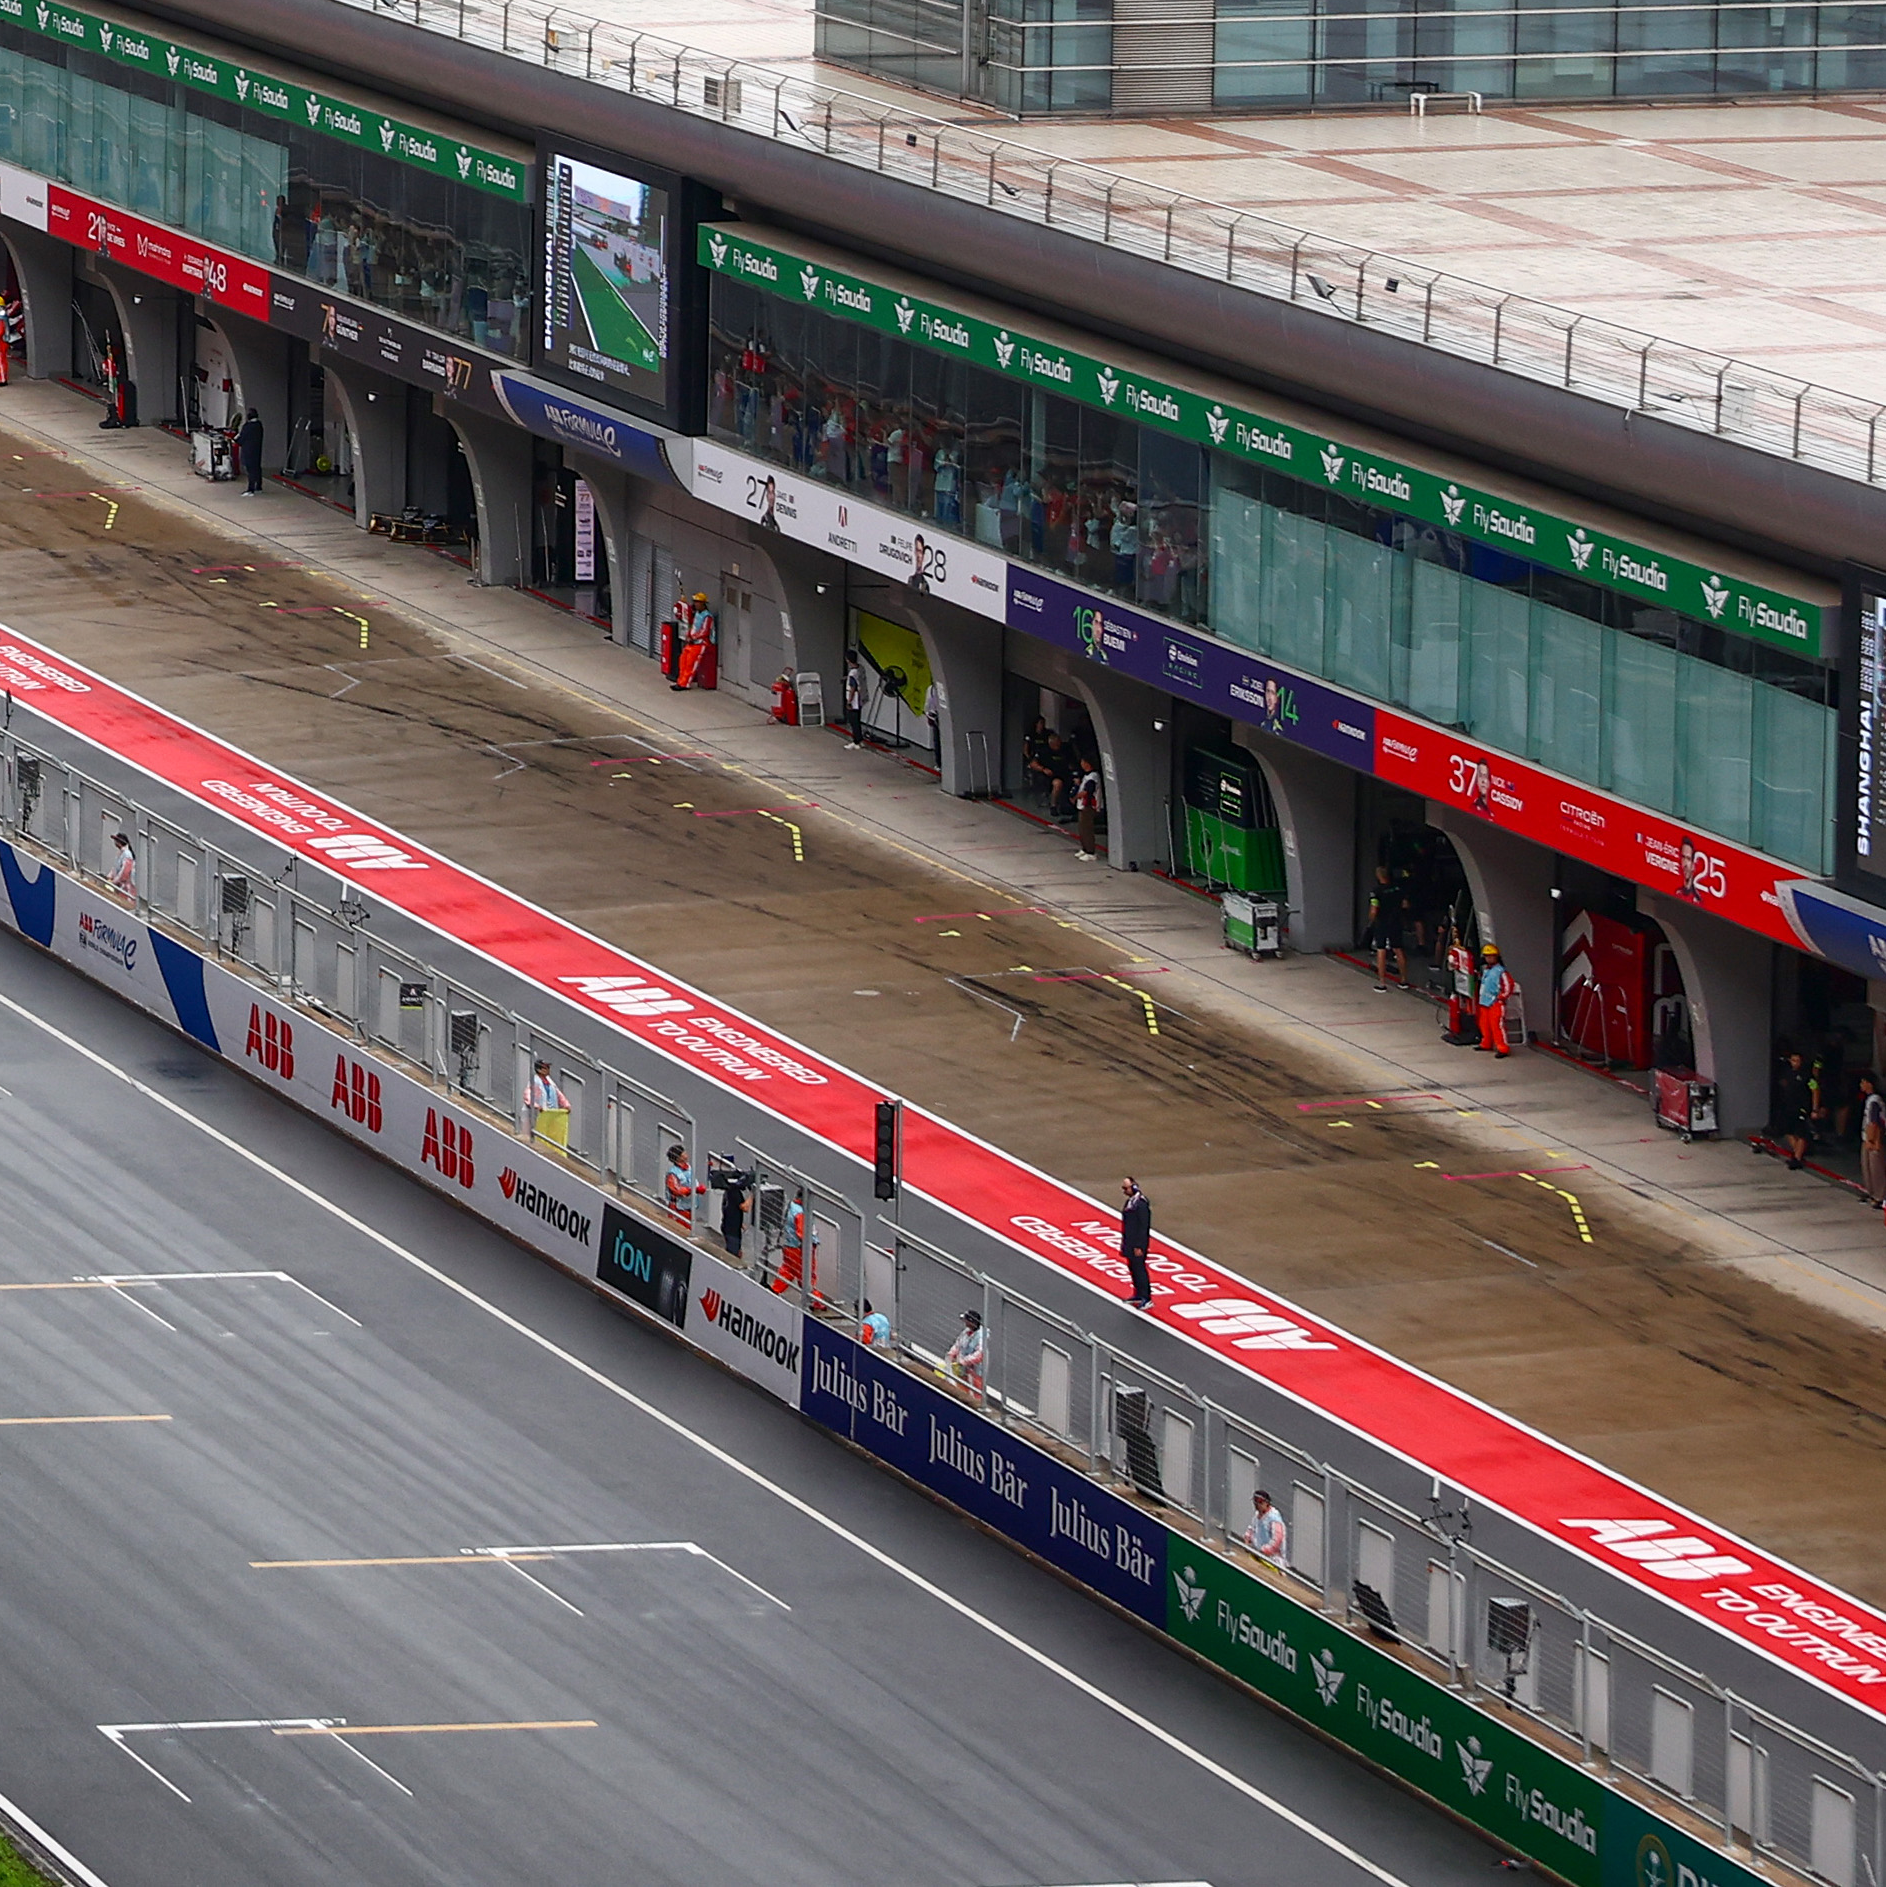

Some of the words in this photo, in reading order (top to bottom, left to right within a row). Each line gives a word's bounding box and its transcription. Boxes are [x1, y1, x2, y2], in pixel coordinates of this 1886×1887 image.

[209, 261, 227, 292] 48
[544, 232, 553, 350] SHANGHAI
[746, 475, 768, 509] 27
[828, 532, 857, 553] ANDRETTI
[879, 543, 913, 565] DRUGOVICH
[923, 545, 946, 583] 28
[1073, 606, 1094, 644] 16
[1229, 684, 1264, 709] ERIKSSON
[1276, 686, 1300, 727] 14
[1449, 754, 1479, 797] 37
[1857, 699, 1872, 856] SHANGHAI
[1491, 789, 1523, 812] CASSIDY
[1694, 852, 1726, 899] 25
[557, 977, 694, 1016] ABB
[245, 1003, 295, 1080] ABB
[647, 1020, 688, 1036] TO
[675, 1036, 772, 1080] OUTRUN
[687, 1017, 828, 1084] ENGINEERED
[331, 1054, 383, 1134] ABB
[421, 1107, 475, 1189] ABB
[811, 1344, 868, 1414] Julius
[871, 1378, 910, 1437] Bär
[929, 1413, 986, 1486] Julius
[989, 1449, 1030, 1510] Bär
[1050, 1485, 1110, 1552] Julius
[1116, 1522, 1156, 1587] Bär
